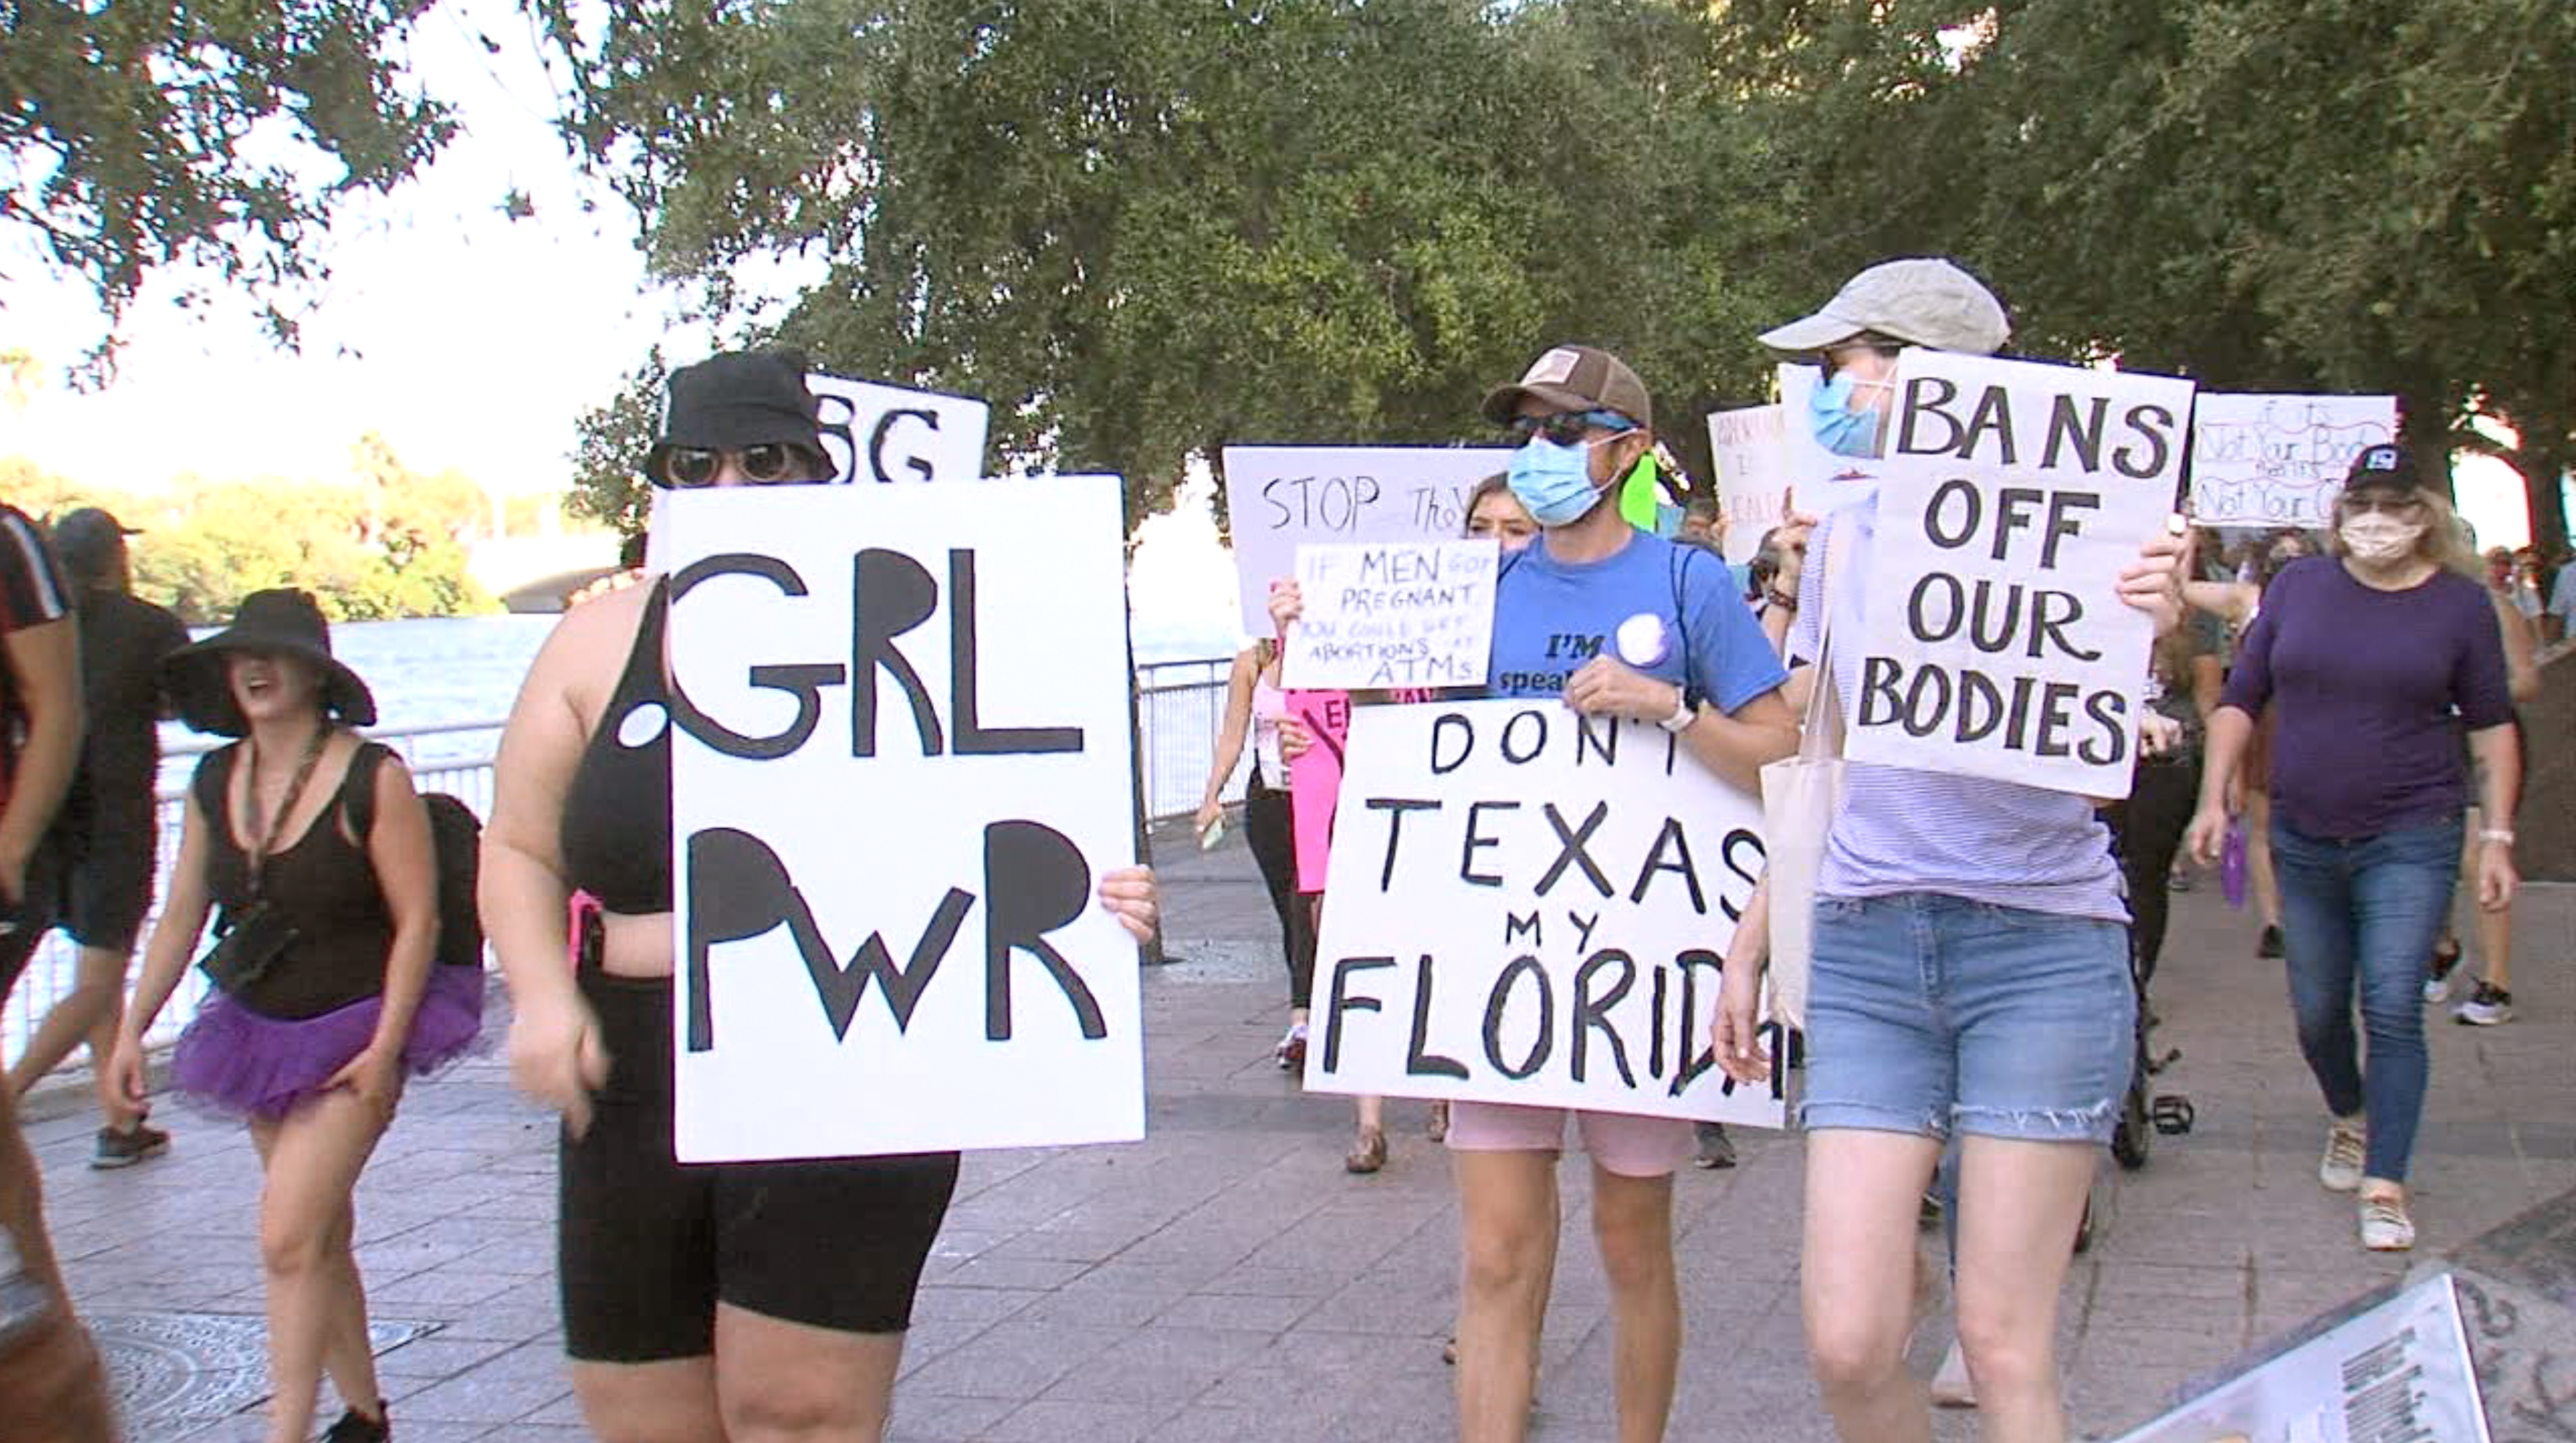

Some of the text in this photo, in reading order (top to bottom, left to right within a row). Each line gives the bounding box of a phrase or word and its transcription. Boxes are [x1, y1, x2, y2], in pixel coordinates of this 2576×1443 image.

[816, 394, 940, 483] BG
[1896, 377, 2175, 479] BANS
[2311, 425, 2367, 465] Bod
[1263, 476, 1380, 533] STOP
[1924, 479, 2100, 569] OFF
[1341, 582, 1476, 616] PREGNANT
[1359, 546, 1441, 586] MEN
[671, 547, 1083, 761] GRL
[1309, 637, 1431, 664] ABORTIONS
[1545, 634, 1605, 659] I'M
[1907, 572, 2102, 662] OUR
[1857, 657, 2127, 766] BODIES
[1364, 798, 1767, 923] TEXAS
[688, 819, 1108, 1052] PWR
[1506, 910, 1599, 954] MY
